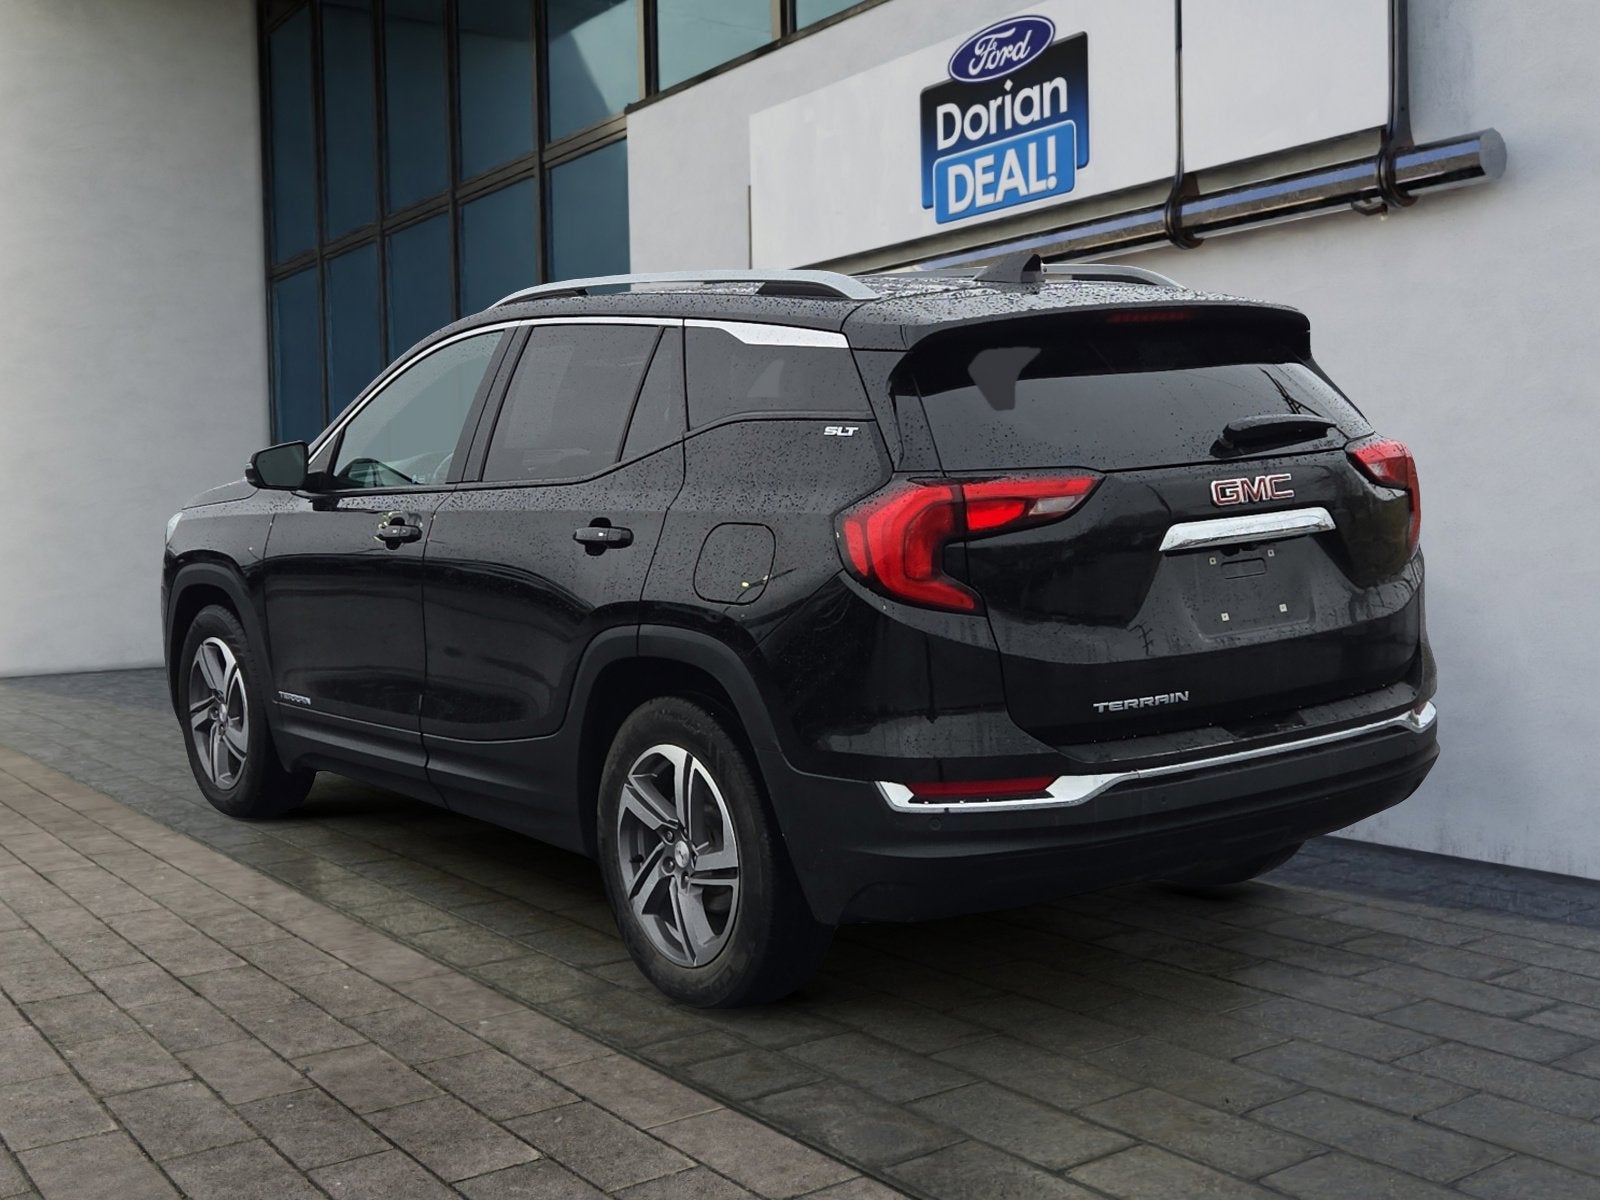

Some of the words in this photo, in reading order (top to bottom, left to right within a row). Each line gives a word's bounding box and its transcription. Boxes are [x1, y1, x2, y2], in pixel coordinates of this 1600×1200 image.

[968, 27, 1032, 76] Ford
[936, 76, 1067, 151] Dorian
[947, 135, 1057, 214] DEAL!
[823, 426, 859, 436] SLT
[1211, 473, 1294, 506] GMC
[1093, 691, 1189, 713] TERRAIN
